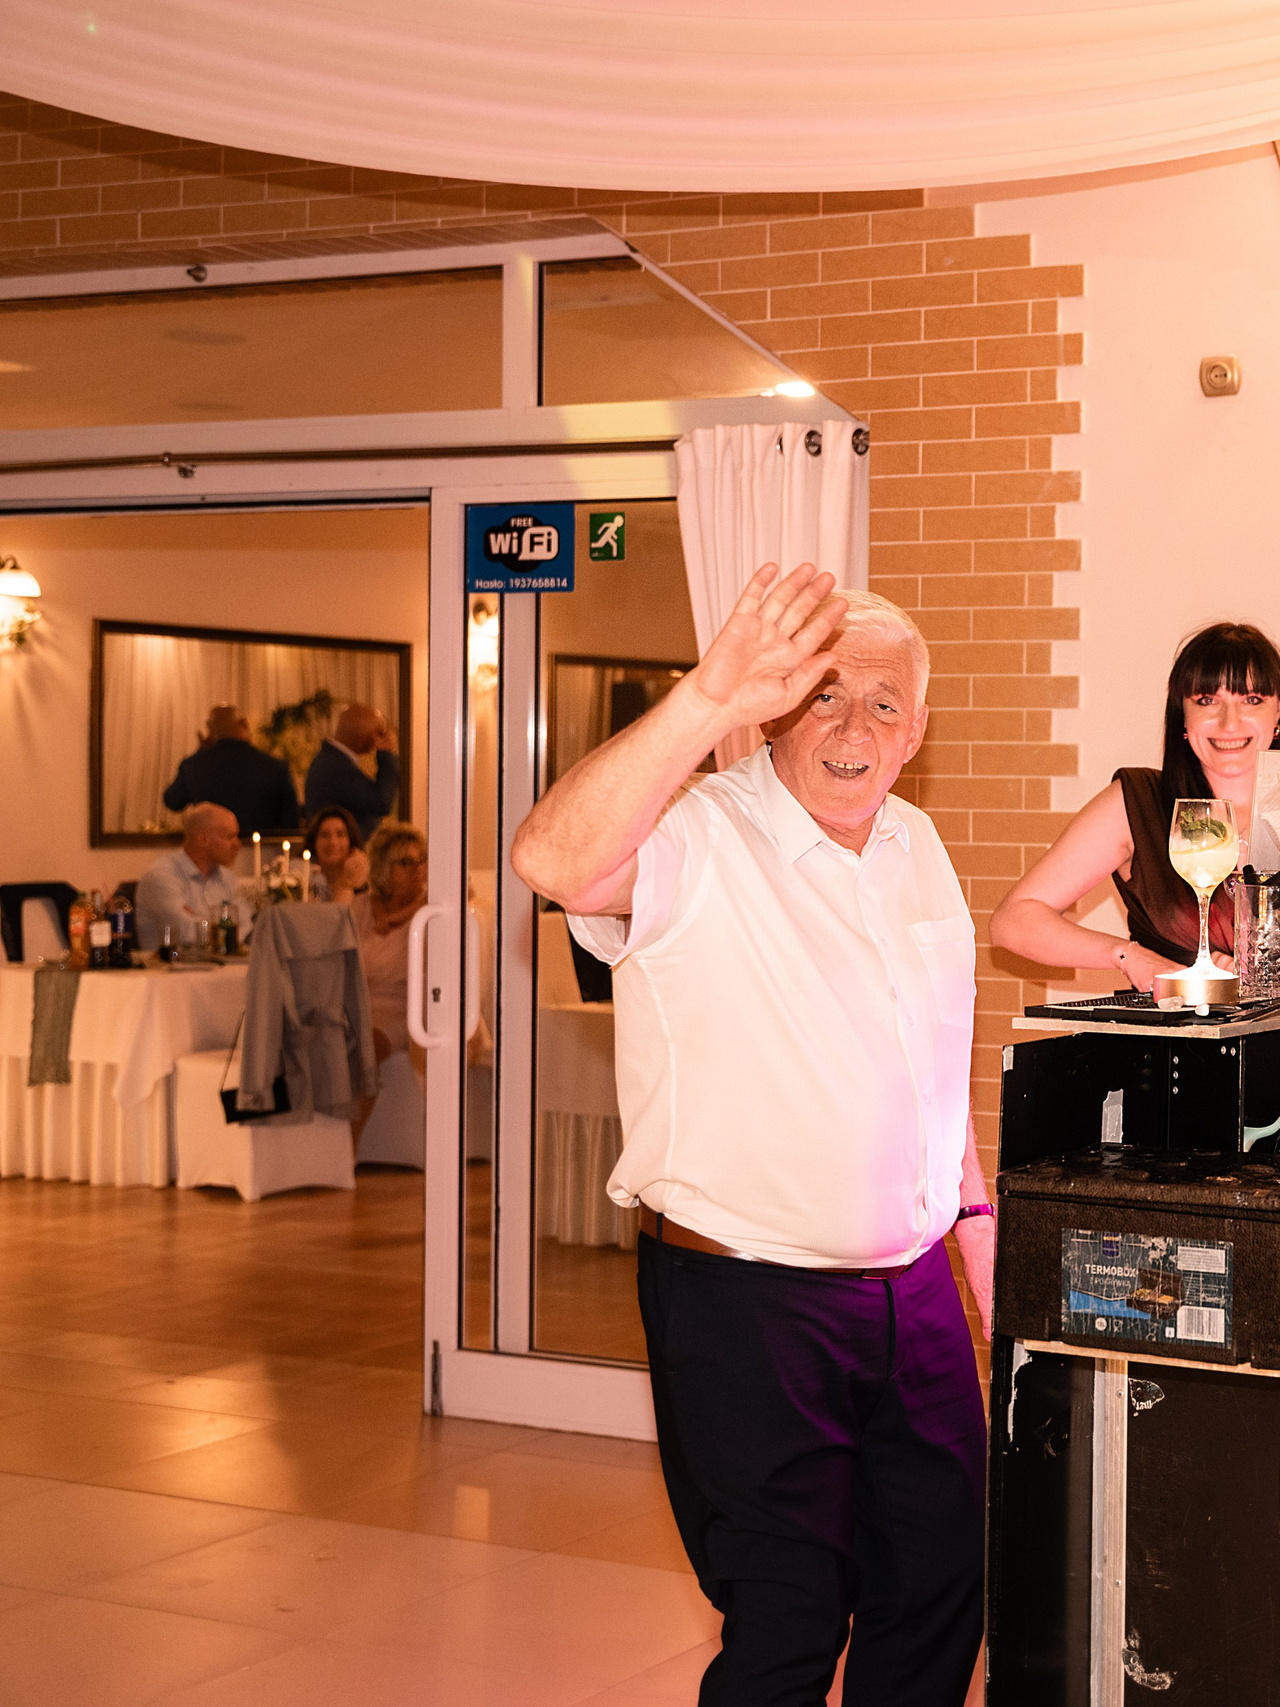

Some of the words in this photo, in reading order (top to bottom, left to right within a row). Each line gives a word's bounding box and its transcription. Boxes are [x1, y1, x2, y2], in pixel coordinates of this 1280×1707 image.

[510, 517, 533, 527] FREE
[489, 531, 553, 555] WiFi
[509, 577, 568, 589] 1937658814
[1084, 1264, 1136, 1278] TERMOBOX
